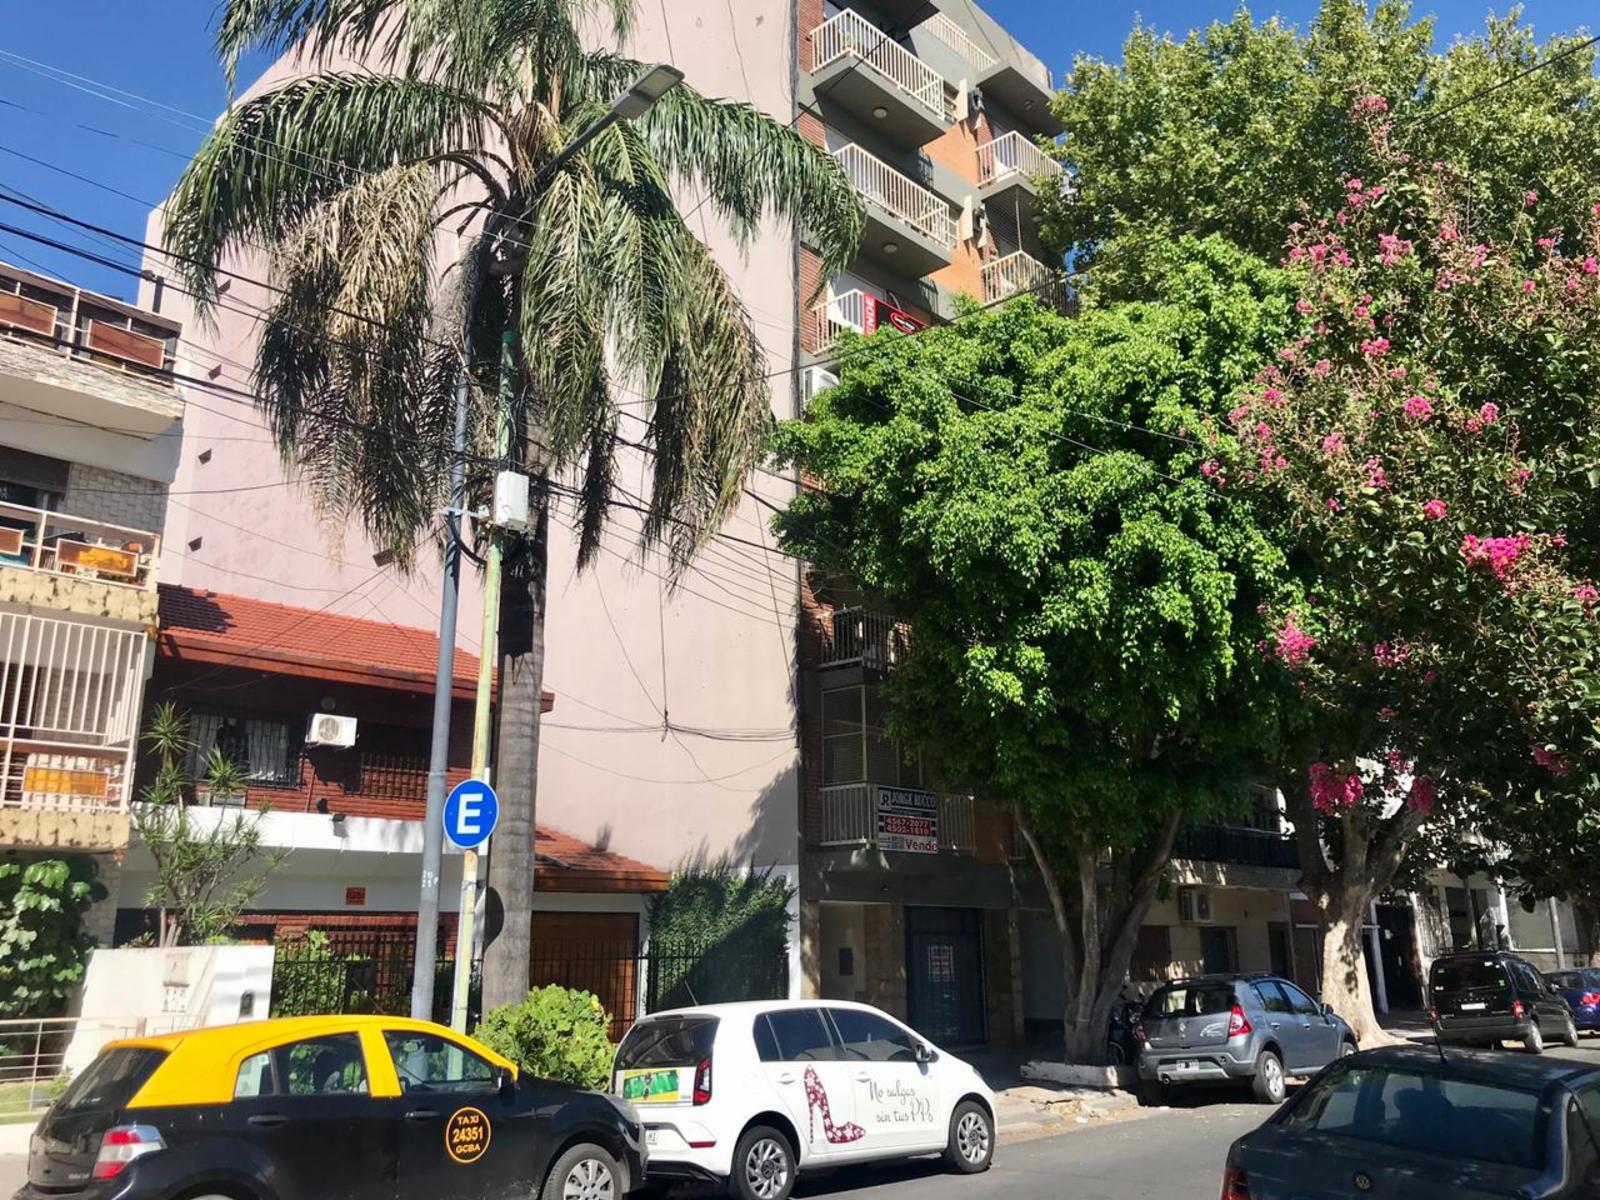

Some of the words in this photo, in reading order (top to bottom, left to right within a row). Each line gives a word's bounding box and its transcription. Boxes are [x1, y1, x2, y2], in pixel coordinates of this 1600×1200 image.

[456, 793, 483, 834] E
[886, 1080, 916, 1106] salgas
[457, 1115, 479, 1125] TAXI
[453, 1126, 483, 1144] 24351
[455, 1143, 481, 1154] GCBA
